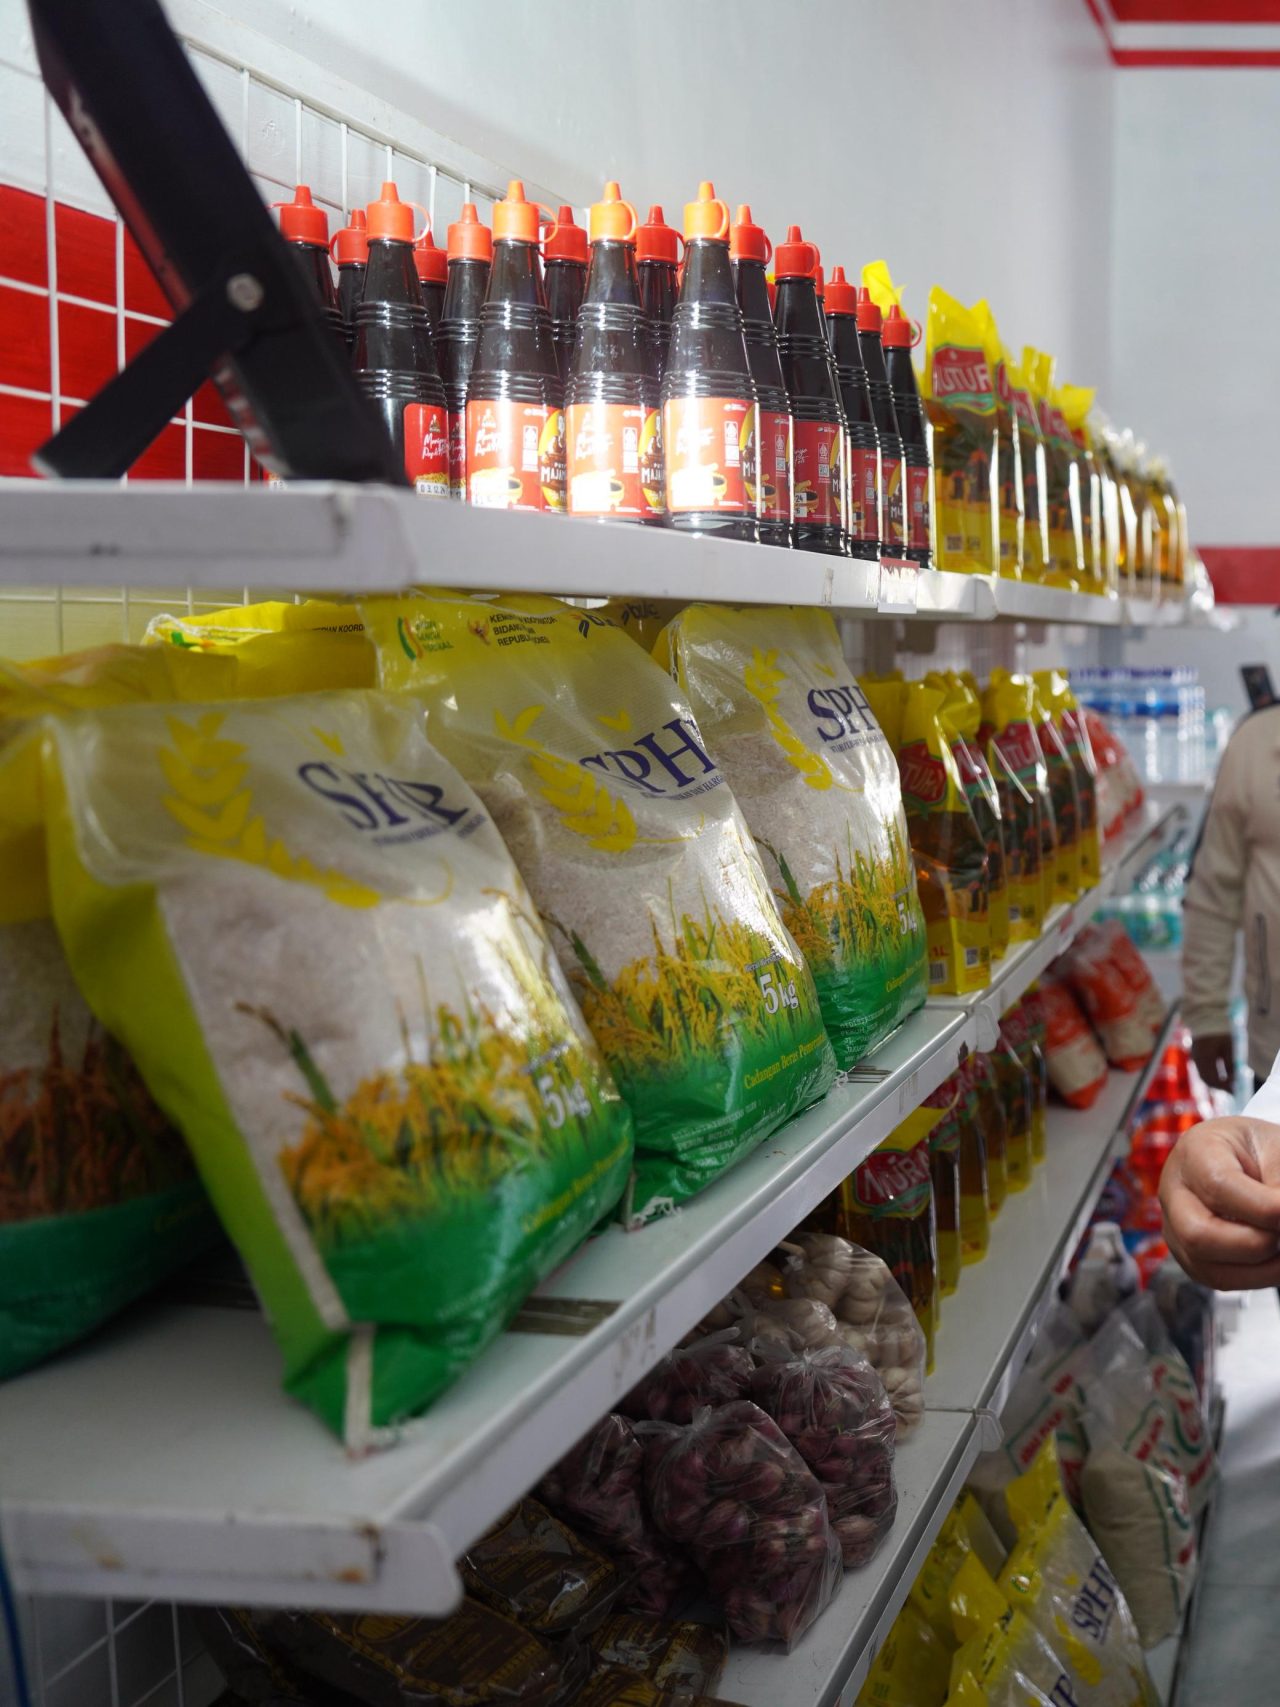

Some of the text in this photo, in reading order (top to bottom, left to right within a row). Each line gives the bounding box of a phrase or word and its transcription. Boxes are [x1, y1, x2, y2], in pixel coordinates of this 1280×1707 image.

[807, 686, 876, 742] SPH
[760, 973, 799, 1014] 5 kg
[538, 1075, 565, 1129] 5
[744, 1062, 780, 1089] Cadangan
[1072, 1556, 1118, 1640] SPH
